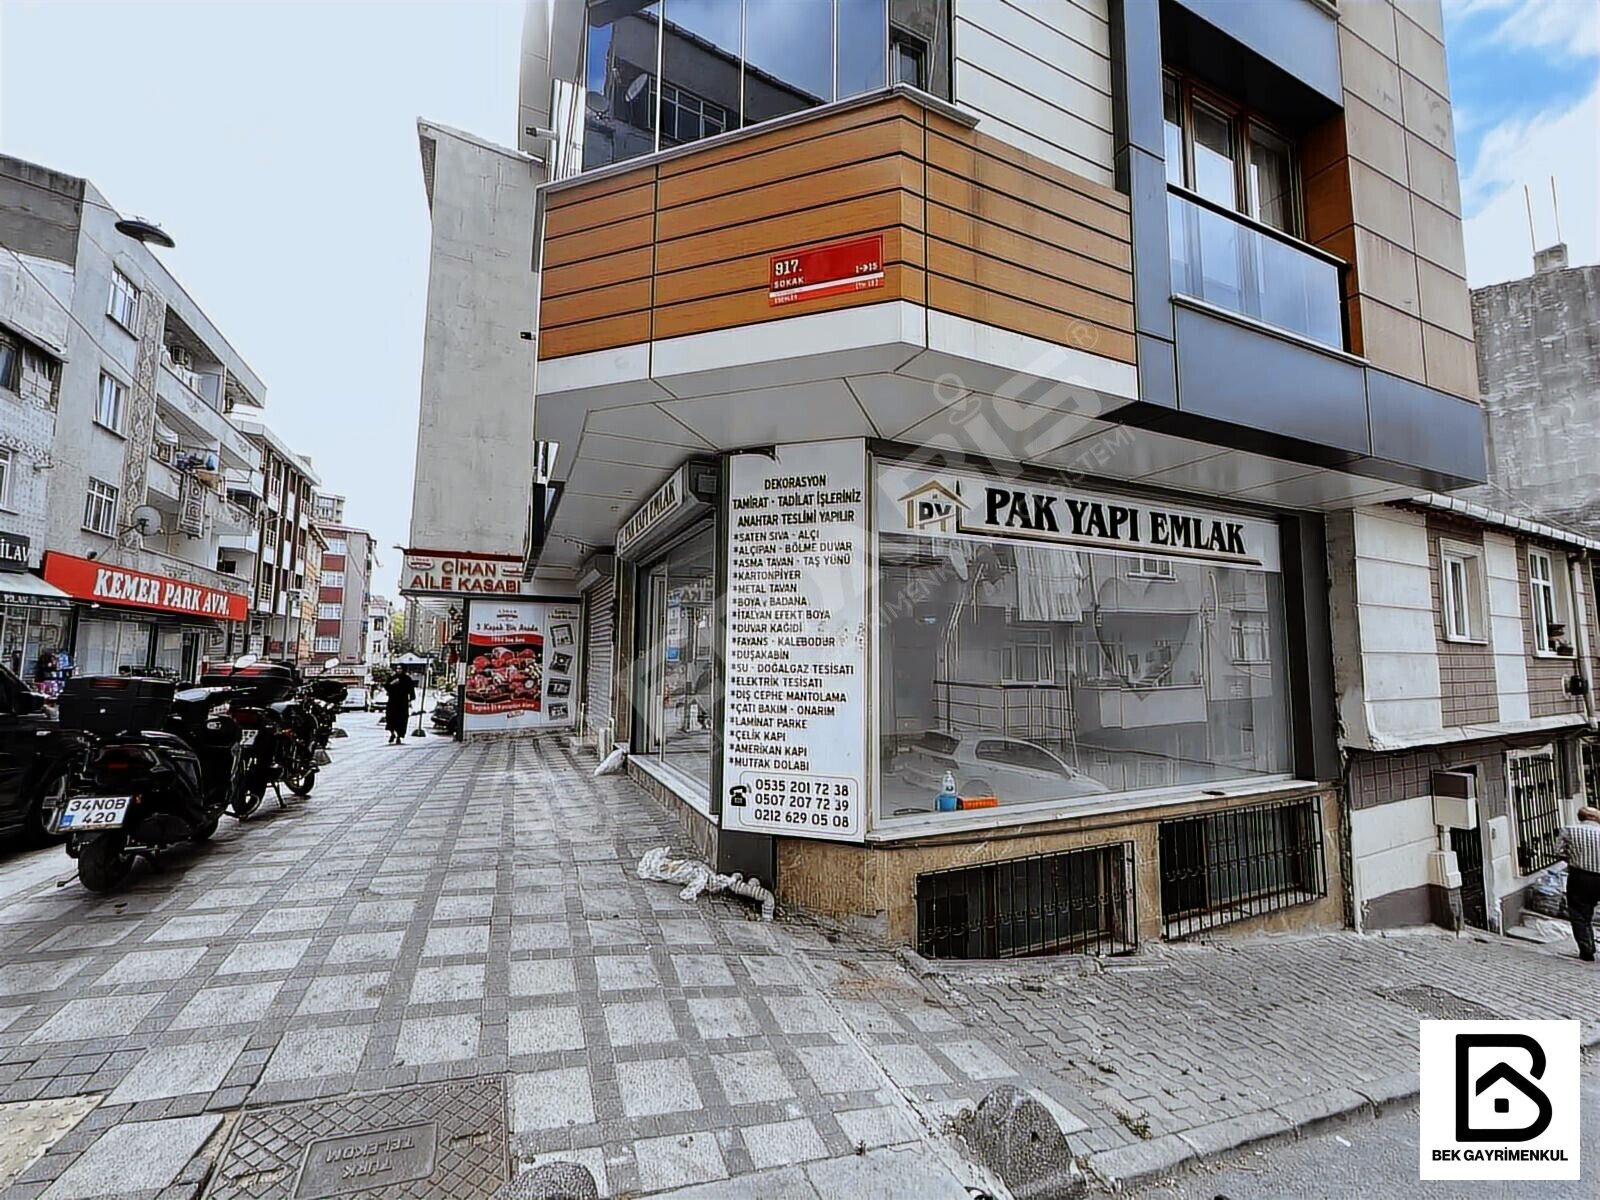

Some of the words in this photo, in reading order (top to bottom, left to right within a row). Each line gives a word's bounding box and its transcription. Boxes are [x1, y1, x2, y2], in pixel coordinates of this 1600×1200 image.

[775, 259, 802, 276] 917.
[774, 277, 804, 288] SOKAK
[765, 475, 826, 490] DEKORASYON
[733, 495, 769, 510] TAMİRAT
[778, 493, 814, 506] TADİLAT
[738, 515, 778, 527] ANAHTAR
[819, 511, 854, 522] YAPILIR
[985, 487, 1059, 531] PAK
[1064, 499, 1139, 541] YAPI
[1150, 512, 1246, 554] EMLAK
[740, 532, 766, 542] SATEN
[769, 531, 788, 540] SIVA
[798, 530, 819, 541] ALÇI
[739, 545, 776, 556] ALÇIPAN
[785, 542, 816, 553] BÖLME
[820, 542, 852, 551] DUVAR
[739, 558, 763, 567] ASMA
[767, 557, 793, 566] TAVAN
[804, 556, 819, 567] TAŞ
[442, 559, 496, 577] CİHAN
[738, 569, 801, 580] KARTONPİYER
[410, 572, 452, 590] AİLE
[458, 578, 520, 593] KASABI
[738, 585, 766, 593] METAL
[770, 583, 797, 592] TAVAN
[94, 569, 160, 604] KEMER
[163, 583, 201, 610] PARK
[203, 593, 229, 615] AVM.
[738, 598, 760, 606] BOYA
[770, 597, 807, 606] BADANA
[738, 609, 772, 619] İTALYAN
[775, 611, 803, 619] EFEKT
[806, 610, 831, 619] BOYA
[737, 624, 767, 632] DUVAR
[737, 637, 768, 645] FAYANS
[737, 664, 748, 672] SU
[757, 663, 809, 673] DOĞALGAZ
[813, 662, 853, 674] TESİSATI
[736, 676, 779, 687] ELEKTRİK
[783, 676, 822, 688] TESİSATI
[736, 691, 750, 700] DIŞ
[754, 691, 783, 700] CEPHE
[786, 692, 846, 702] MANTOLAMA
[736, 704, 756, 715] ÇATI
[758, 705, 787, 714] BAKIM
[797, 706, 835, 716] ONARIM
[735, 716, 773, 727] LAMİNAT
[777, 718, 808, 729] PARKE
[736, 730, 761, 741] ÇELİK
[764, 732, 786, 741] KAPI
[735, 743, 782, 755] AMERİKAN
[784, 747, 807, 757] KAPI
[735, 758, 770, 769] MUTFAK
[774, 760, 809, 770] DOLABI
[756, 779, 785, 791] 0535
[790, 781, 811, 793] 201
[815, 783, 829, 795] 72
[834, 785, 849, 796] 38
[755, 794, 785, 805] 0507
[789, 796, 812, 808] 207
[816, 798, 830, 809] 72
[835, 799, 849, 811] 39
[83, 812, 116, 823] 420
[755, 809, 781, 821] 0212
[785, 812, 807, 823] 629
[812, 814, 828, 826] 05
[833, 816, 849, 827] 08
